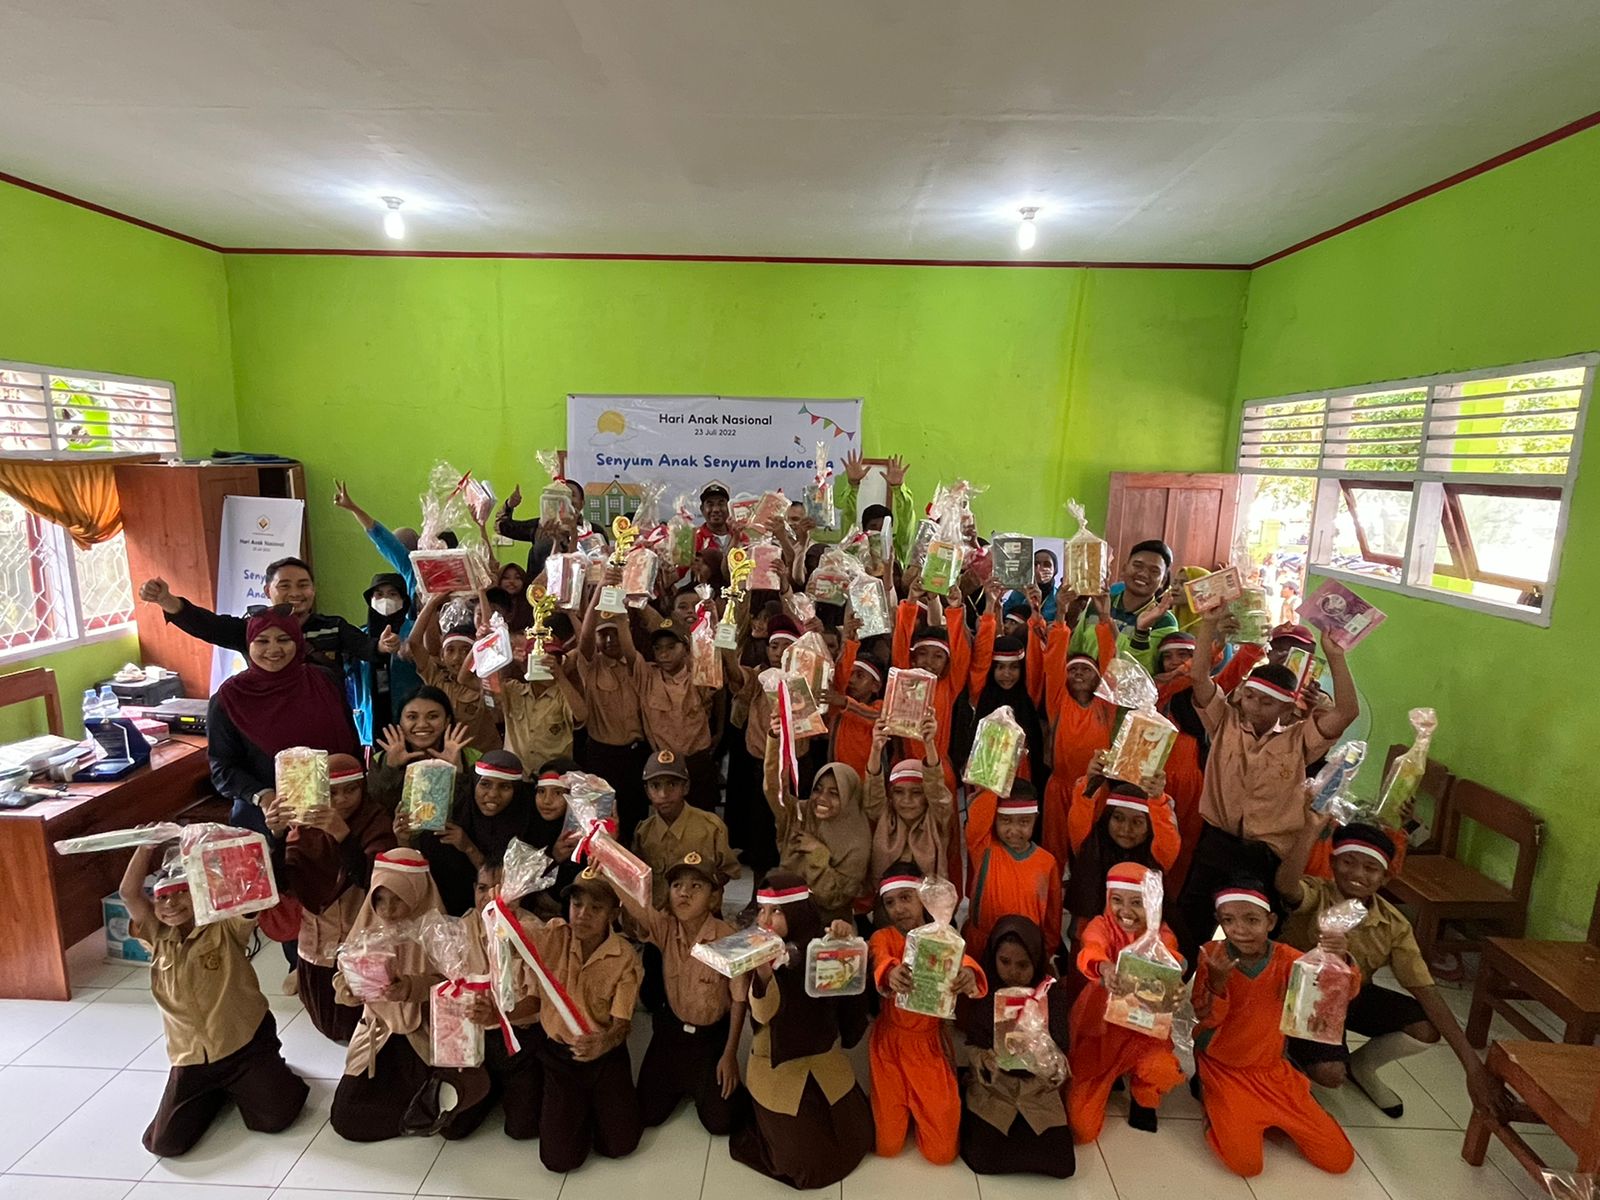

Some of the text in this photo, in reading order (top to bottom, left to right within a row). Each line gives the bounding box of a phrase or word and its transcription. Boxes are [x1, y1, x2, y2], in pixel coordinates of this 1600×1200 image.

[659, 413, 772, 425] Hari Anak Nasional
[596, 452, 653, 471] Senyum
[658, 453, 698, 467] Anak
[703, 455, 761, 473] Senyum
